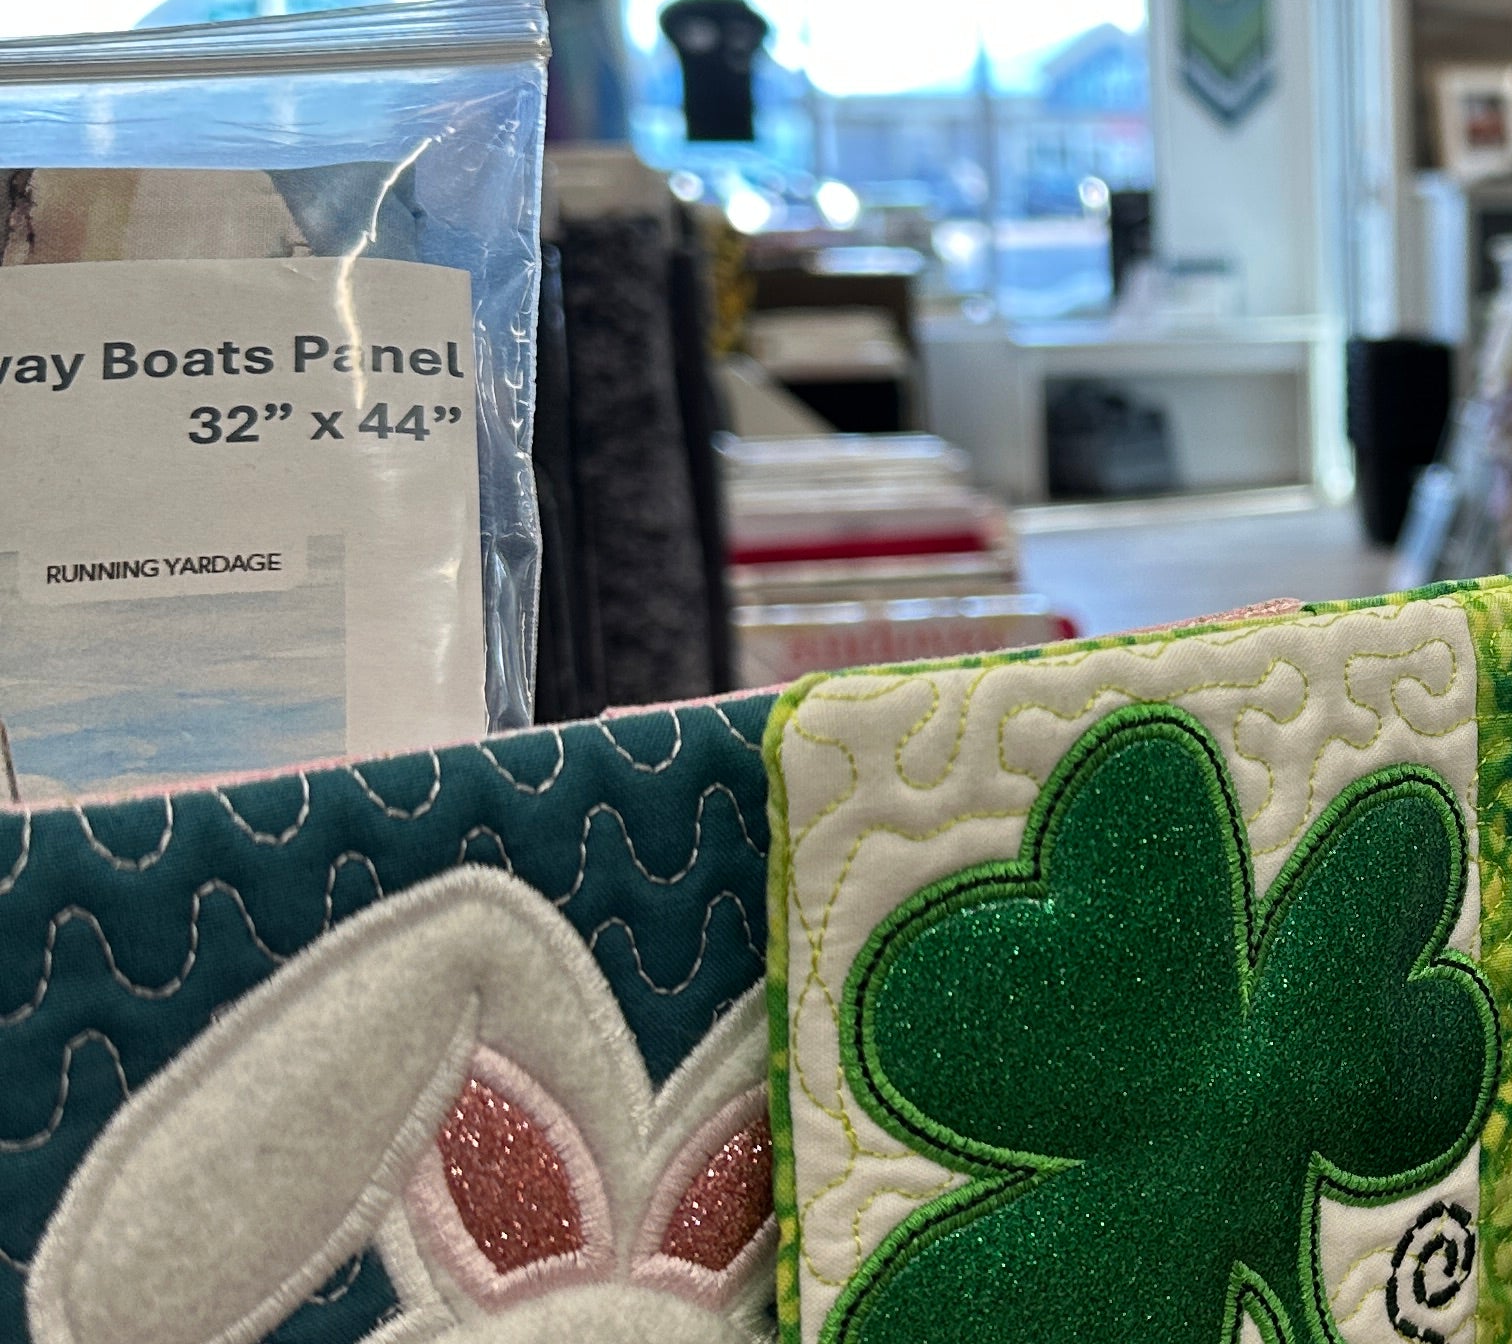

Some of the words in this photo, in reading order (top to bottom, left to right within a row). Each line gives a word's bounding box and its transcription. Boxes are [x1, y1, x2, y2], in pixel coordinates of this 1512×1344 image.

[102, 341, 275, 380] Boats
[294, 336, 465, 378] Panel
[310, 410, 345, 441] x
[46, 558, 160, 584] RUNNING
[163, 553, 283, 576] YARDAGE
